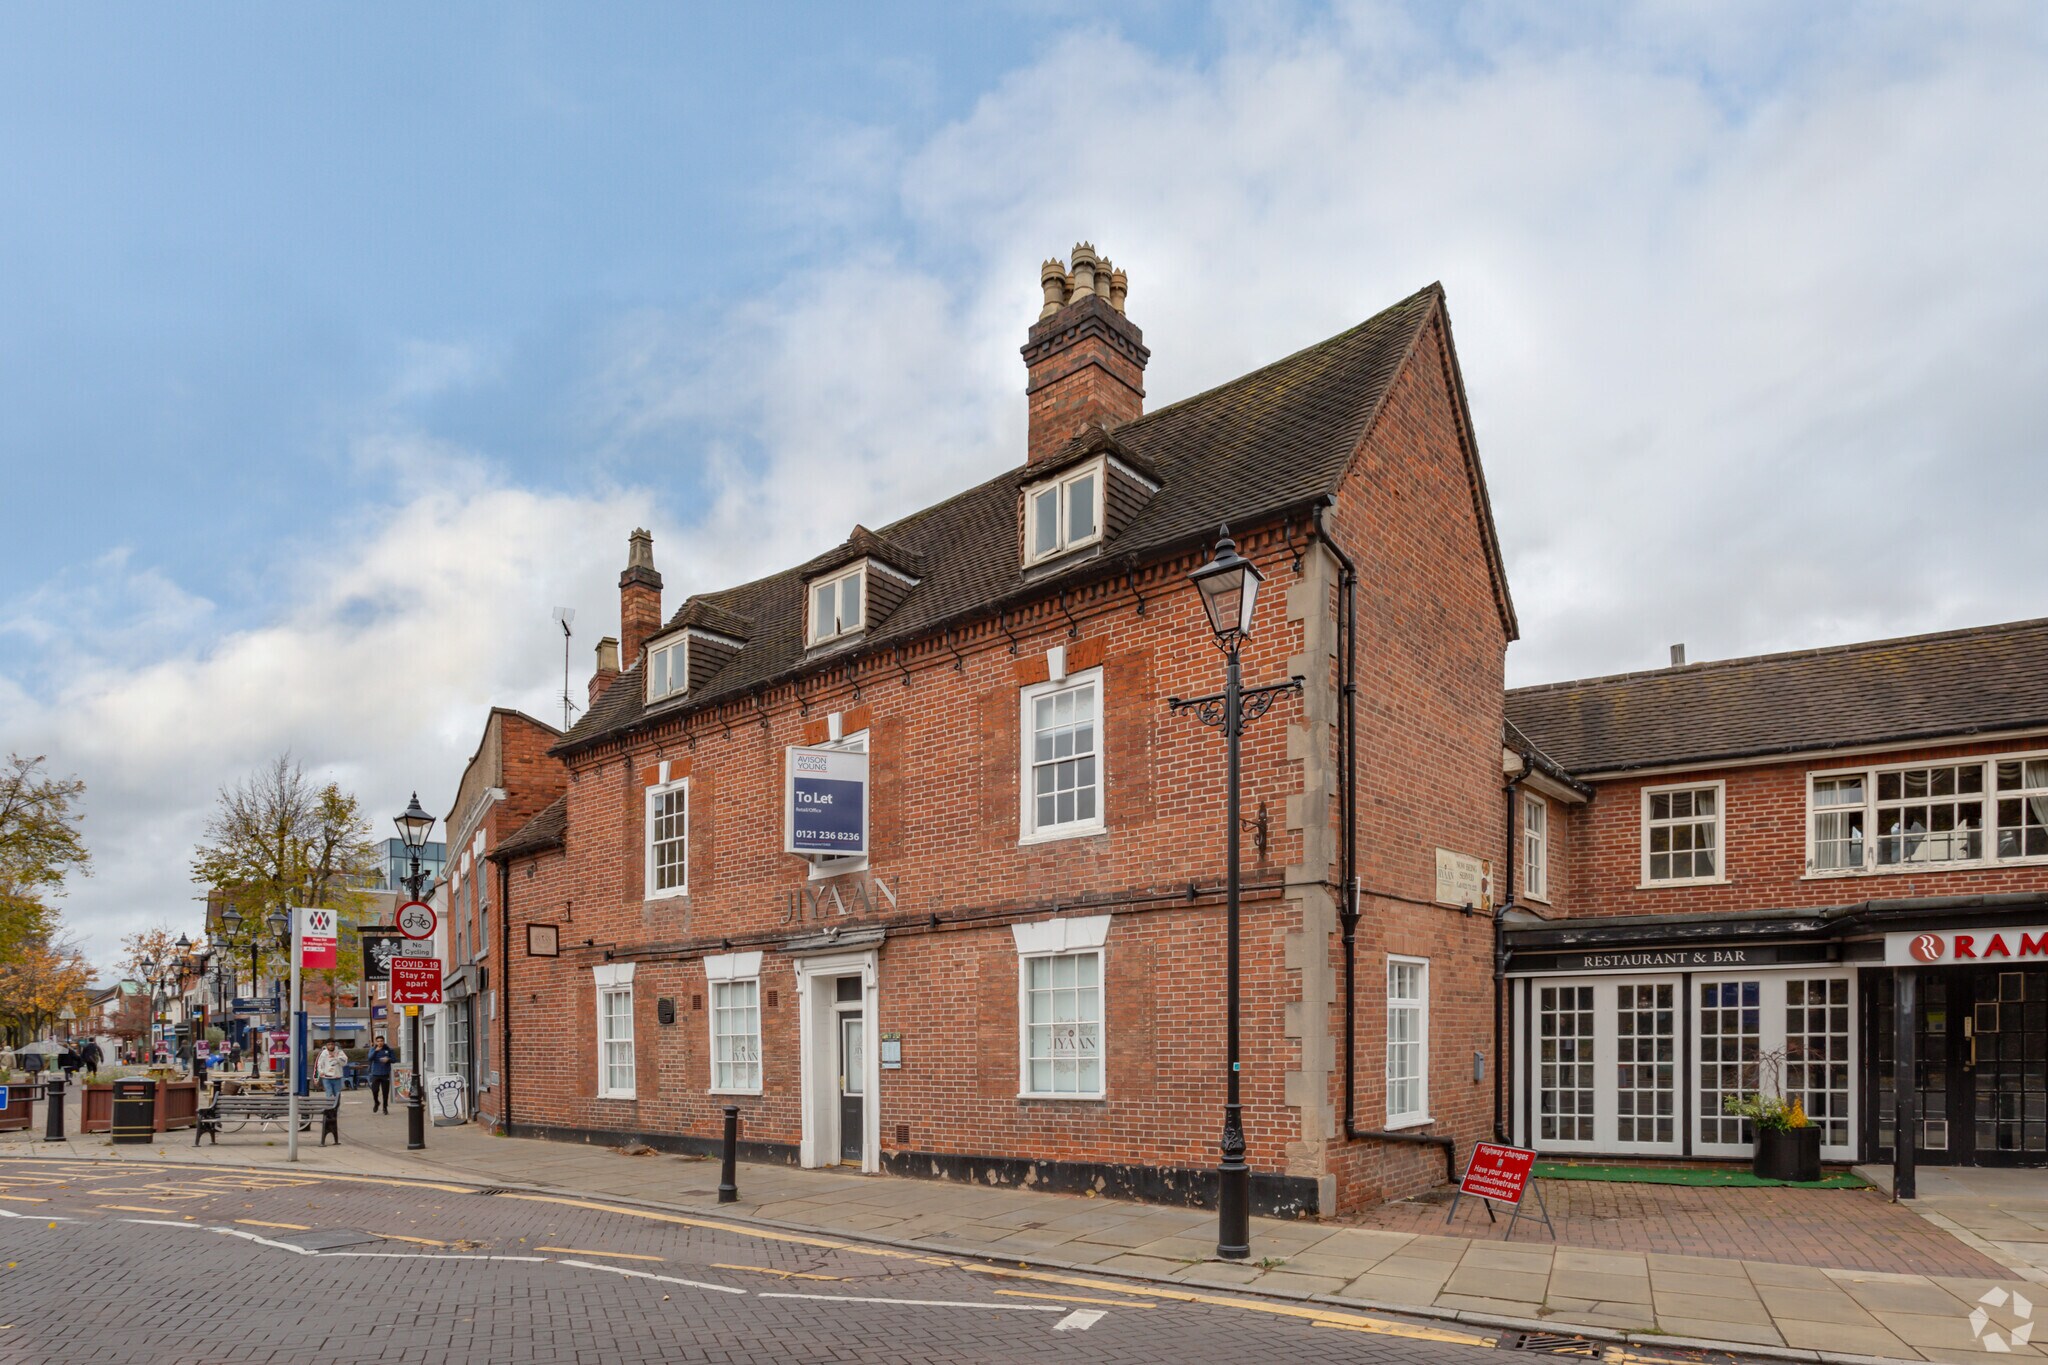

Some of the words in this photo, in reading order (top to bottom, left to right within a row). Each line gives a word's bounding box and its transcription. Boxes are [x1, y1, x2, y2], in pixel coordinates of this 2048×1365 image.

[797, 755, 827, 764] AVISON
[797, 762, 827, 771] YOUNG
[796, 791, 812, 803] To
[813, 792, 833, 804] Let
[796, 830, 817, 839] 0121
[819, 831, 836, 839] 236
[837, 832, 860, 841] 8236
[780, 876, 899, 924] JIYAAN
[394, 960, 424, 968] COVID
[1583, 952, 1688, 967] RESTAURANT
[1693, 952, 1707, 963] &
[1713, 950, 1746, 963] BAR
[399, 971, 418, 980] Stay
[1480, 1145, 1505, 1157] Highway
[1504, 1150, 1529, 1161] changes
[1474, 1165, 1488, 1174] Have
[1488, 1168, 1502, 1176] your
[1502, 1171, 1513, 1180] say
[1513, 1172, 1521, 1181] at
[1469, 1183, 1513, 1199] commonplace.is
